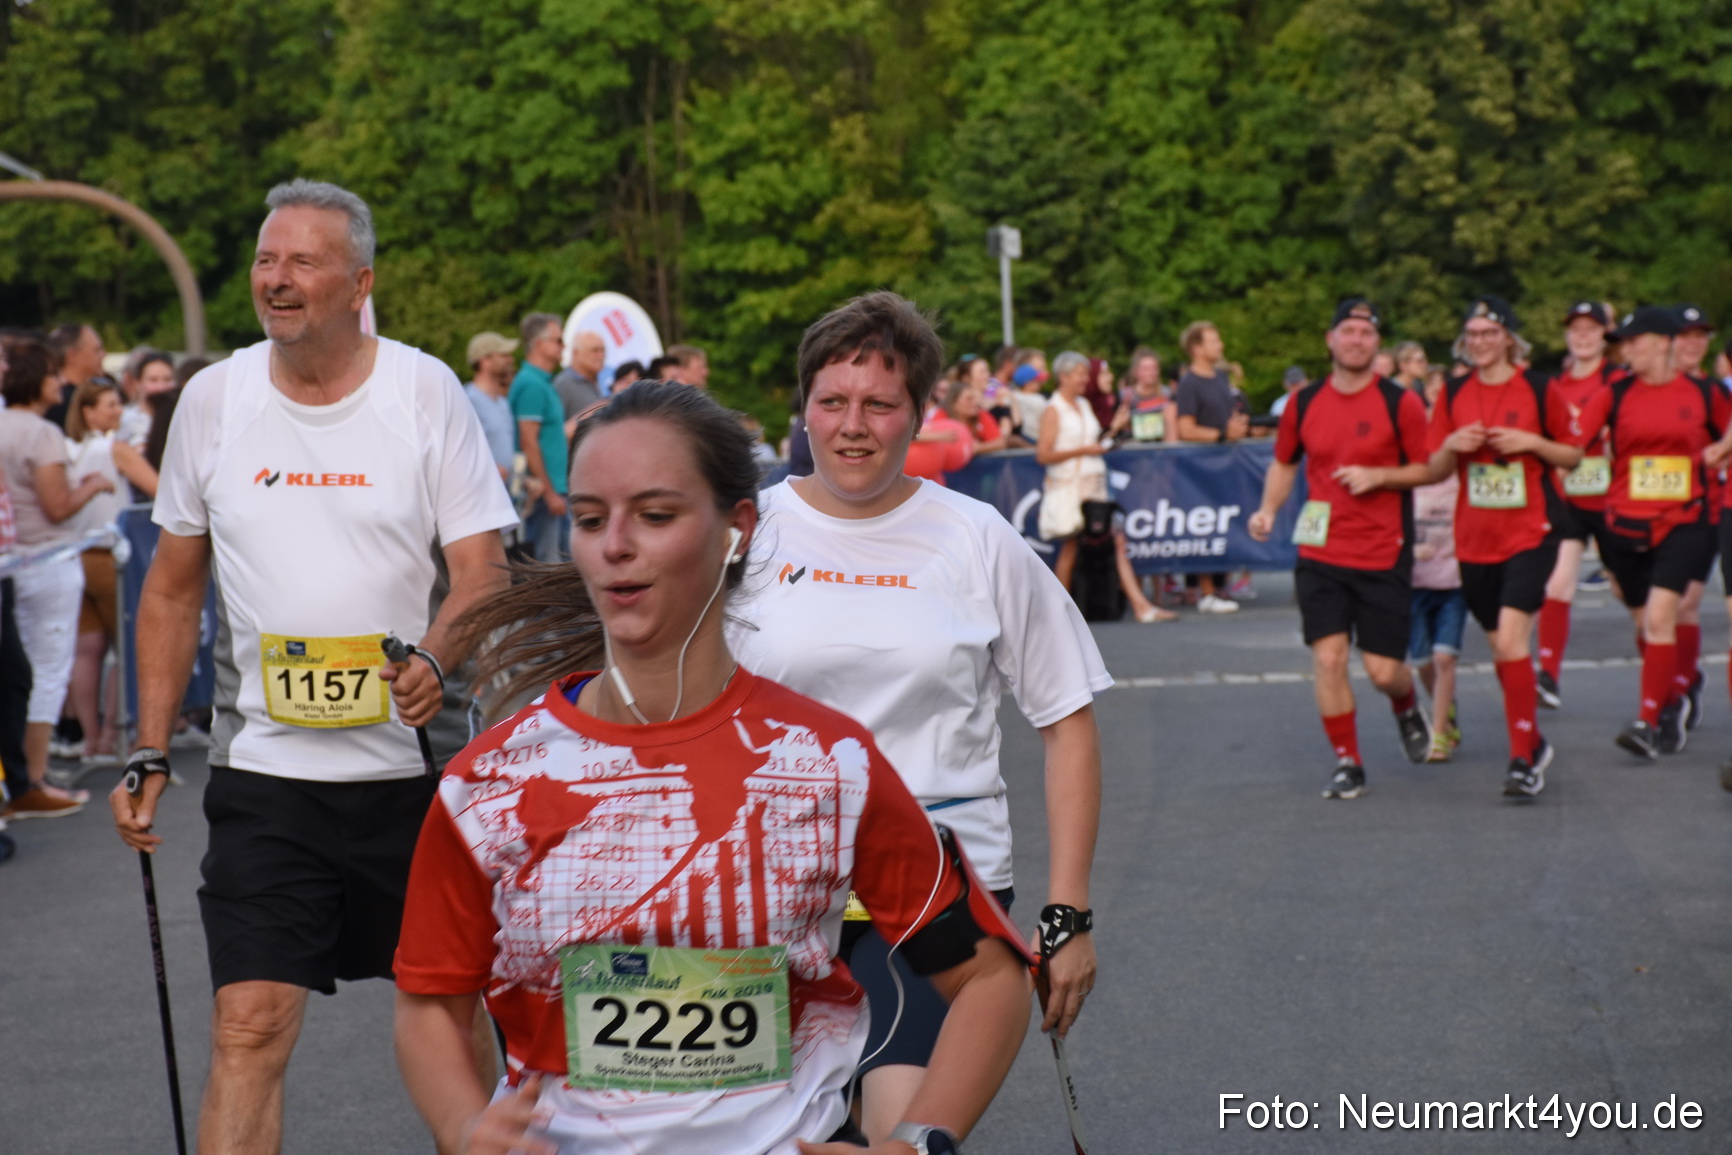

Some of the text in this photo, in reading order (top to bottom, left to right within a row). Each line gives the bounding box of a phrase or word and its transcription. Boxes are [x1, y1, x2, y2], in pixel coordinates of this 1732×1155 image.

[286, 473, 373, 486] KLEBL
[1125, 500, 1240, 539] cher
[812, 569, 918, 590] KLEBL
[277, 668, 369, 702] 1157
[591, 996, 758, 1052] 2229
[680, 1053, 736, 1069] Carina
